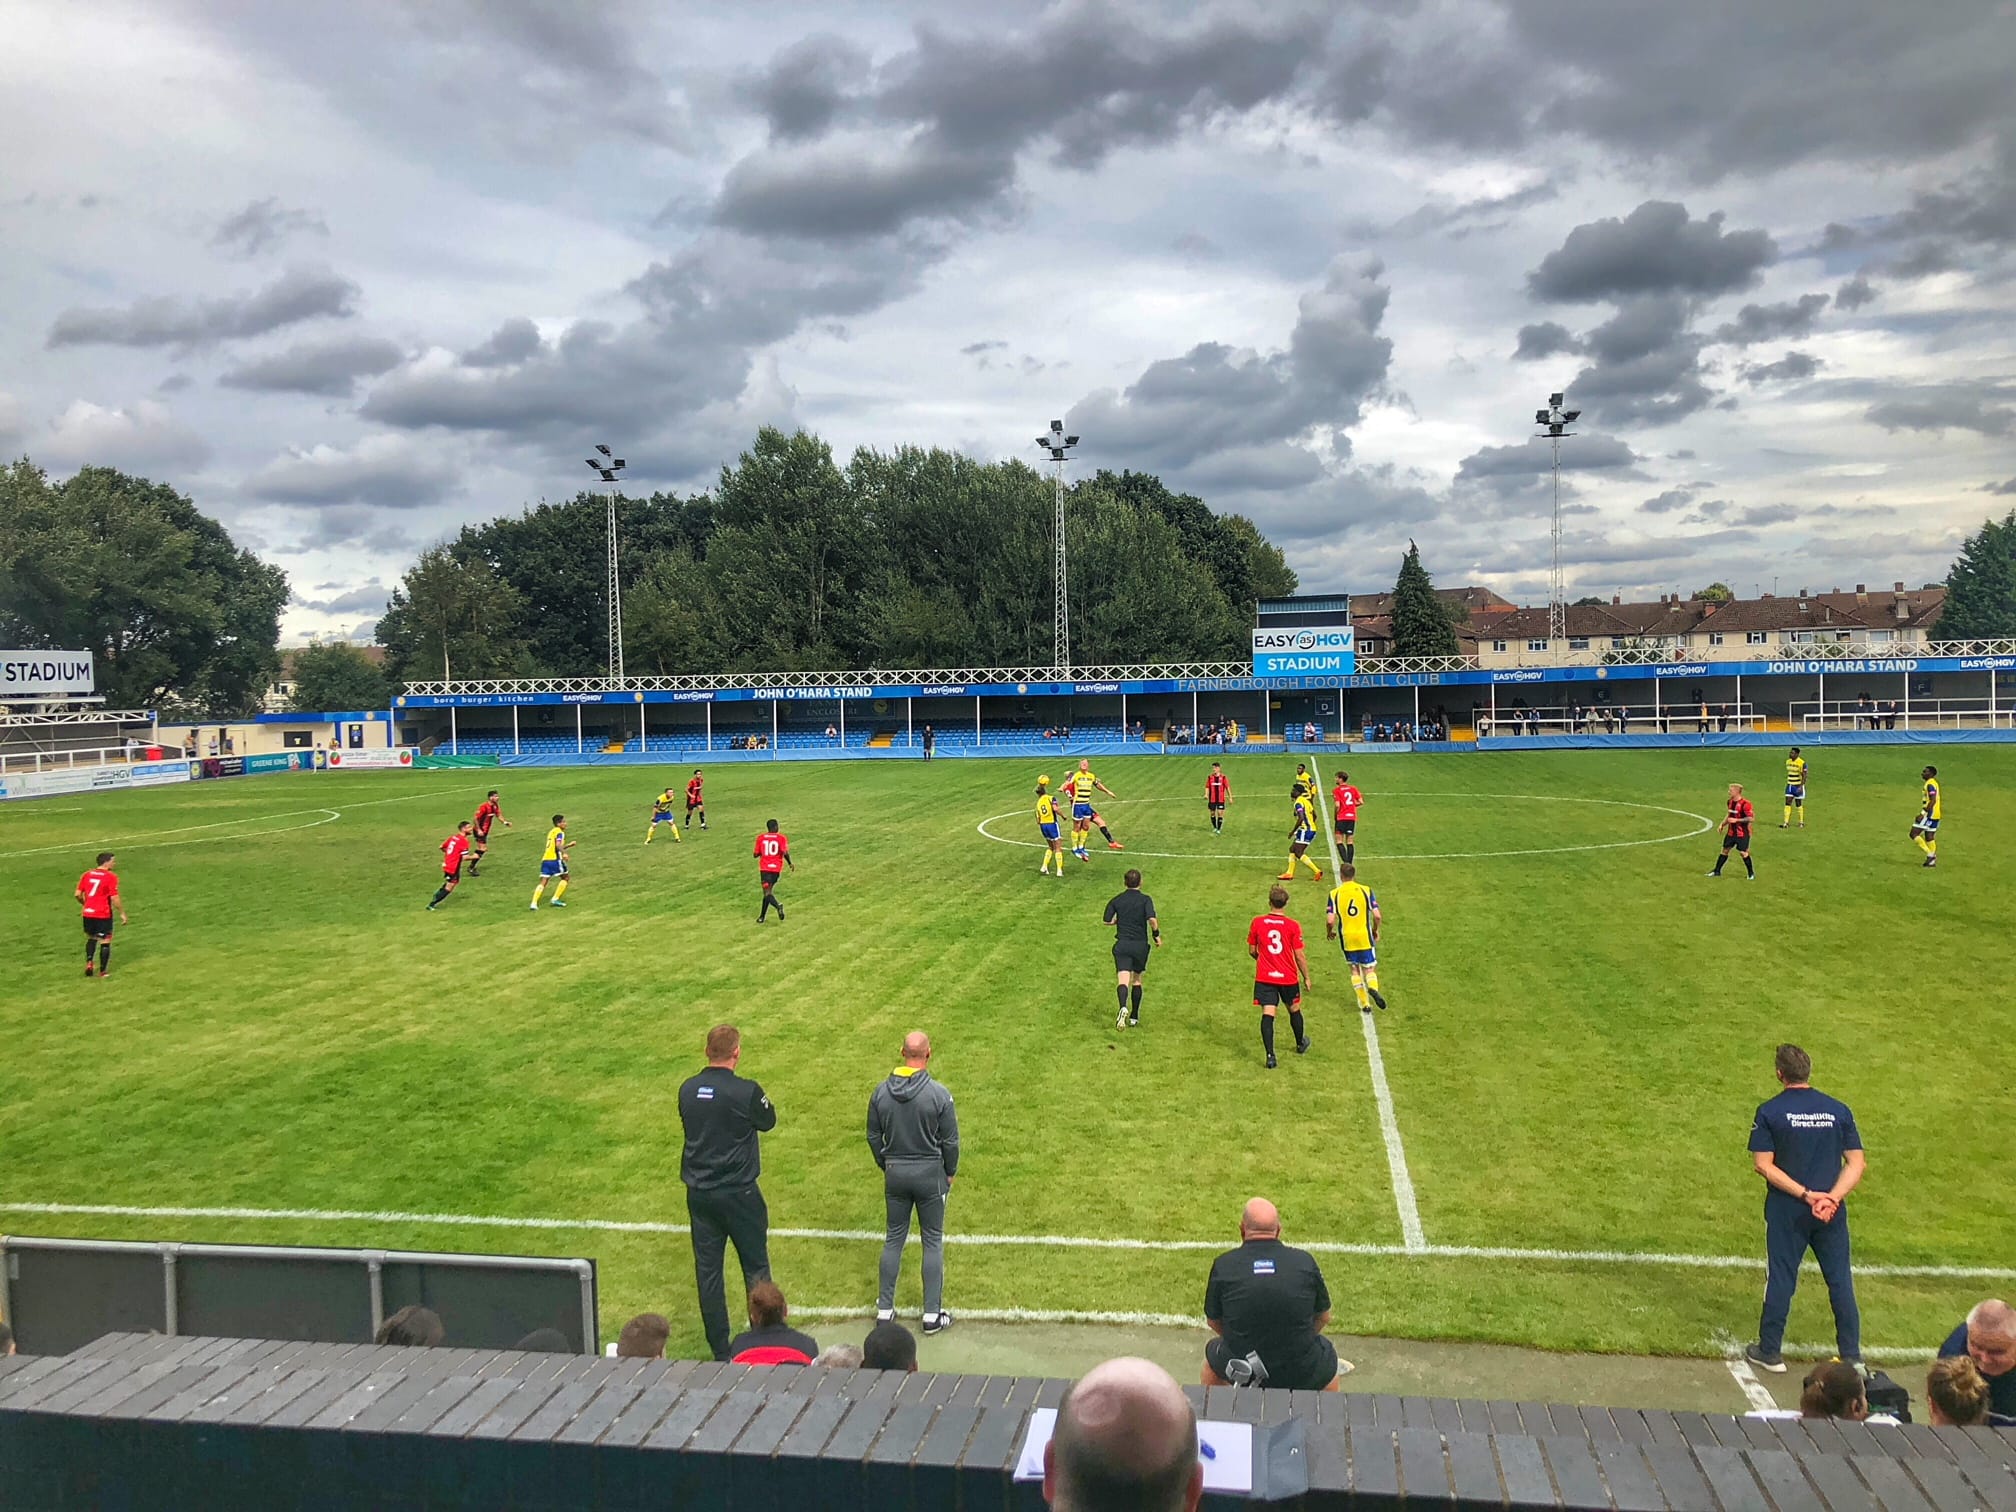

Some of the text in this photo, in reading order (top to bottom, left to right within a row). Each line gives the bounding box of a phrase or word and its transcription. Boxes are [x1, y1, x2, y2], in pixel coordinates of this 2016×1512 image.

[1267, 656, 1340, 670] STADIUM
[1766, 660, 1917, 673] JOHN O'HARA STAND
[5, 662, 90, 681] STADIUM
[1179, 673, 1440, 691] FARNBOROUGH FOOTBALL CLUB
[753, 686, 872, 699] JOHN O'HARA STAND
[461, 696, 492, 705] burger
[499, 695, 534, 703] kitchen
[1321, 703, 1329, 711] D
[113, 769, 131, 780] HGV
[1343, 791, 1354, 805] 2
[1040, 804, 1048, 815] 8
[762, 840, 779, 856] 10
[89, 878, 101, 897] 7
[1347, 898, 1359, 917] 6
[1267, 929, 1283, 955] 3
[1786, 1112, 1836, 1121] FootballKits
[1791, 1120, 1833, 1128] Direct.com
